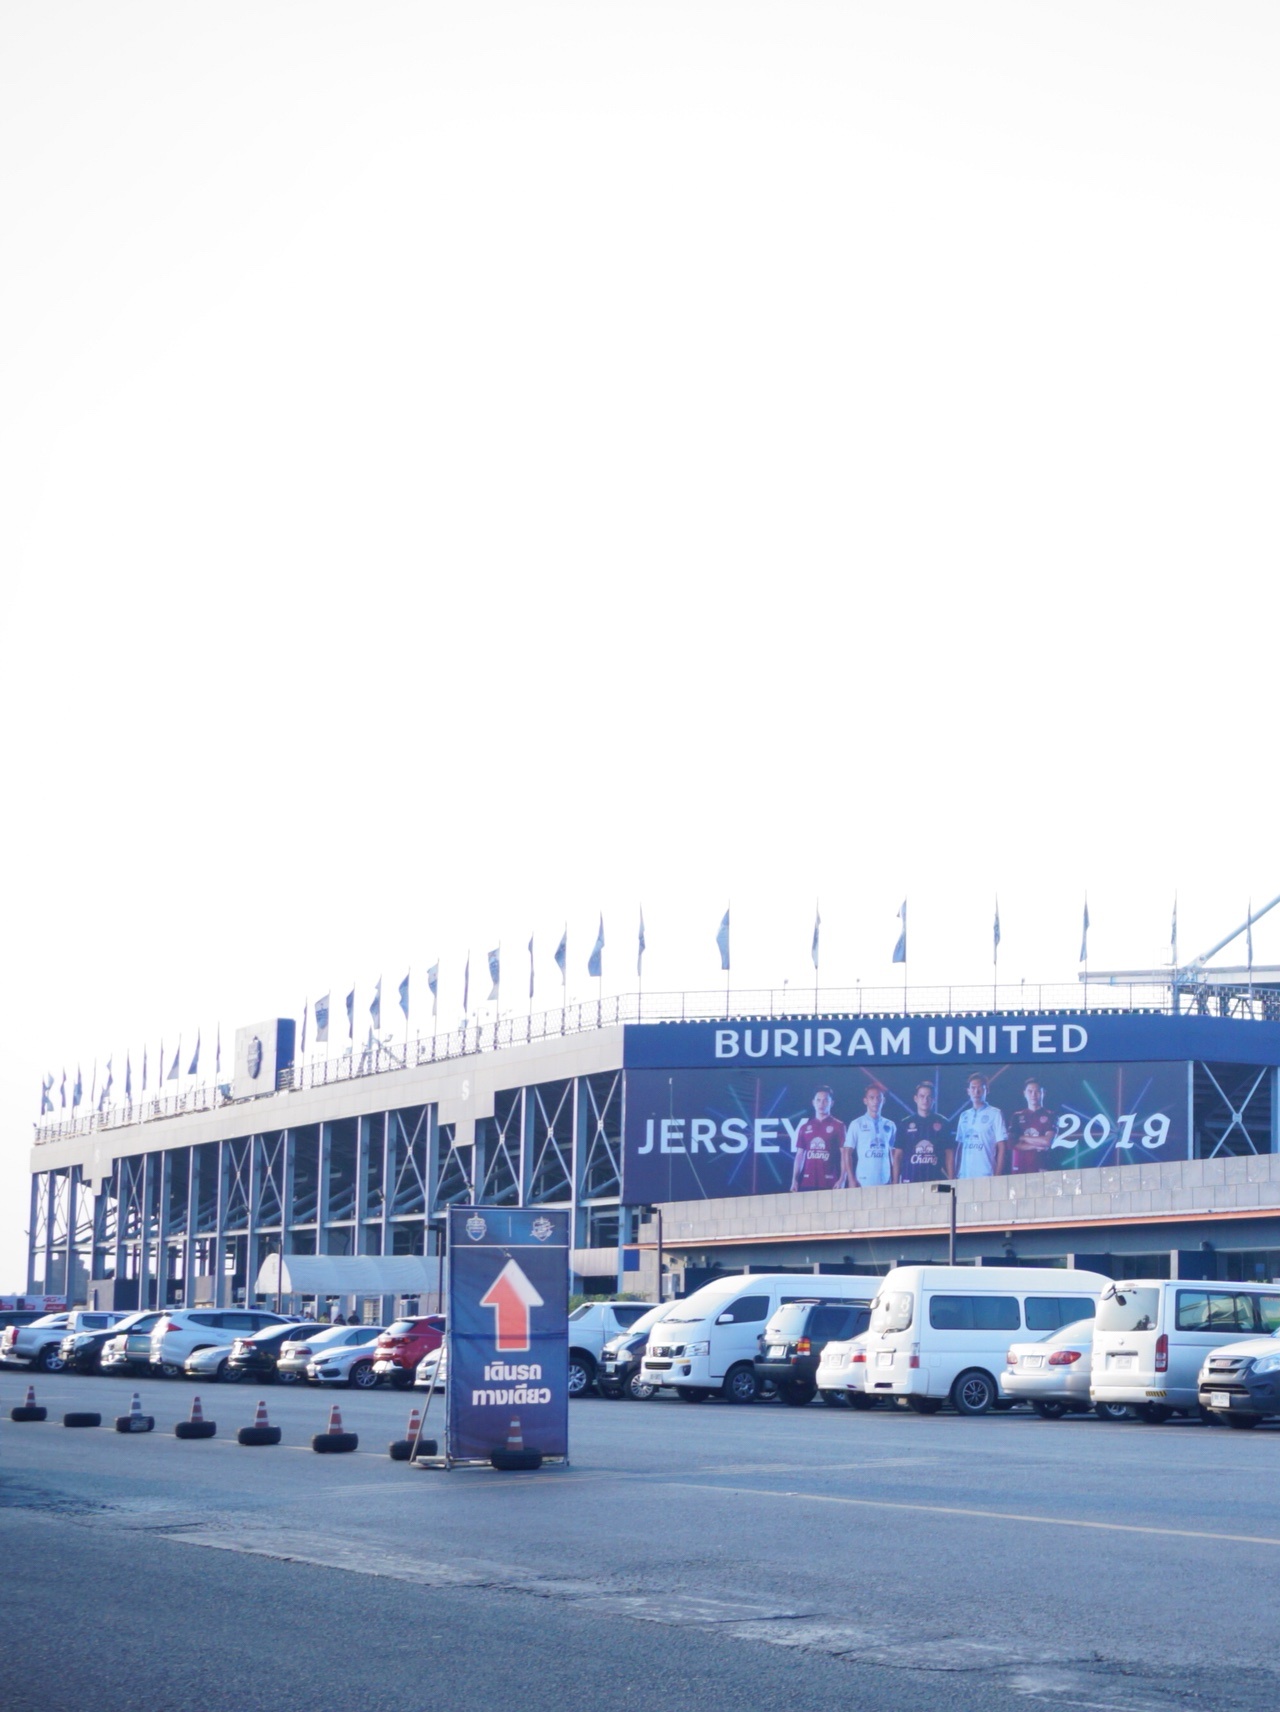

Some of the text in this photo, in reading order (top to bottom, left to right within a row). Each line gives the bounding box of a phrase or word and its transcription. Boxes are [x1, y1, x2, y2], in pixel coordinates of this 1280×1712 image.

[715, 1024, 1088, 1058] BURIRAM UNITED
[638, 1113, 1170, 1155] JERSEY 2019
[807, 1150, 830, 1162] Chang
[910, 1153, 937, 1165] Chang
[484, 1361, 541, 1381] เดินรถ
[472, 1384, 551, 1406] ทางเดียว
